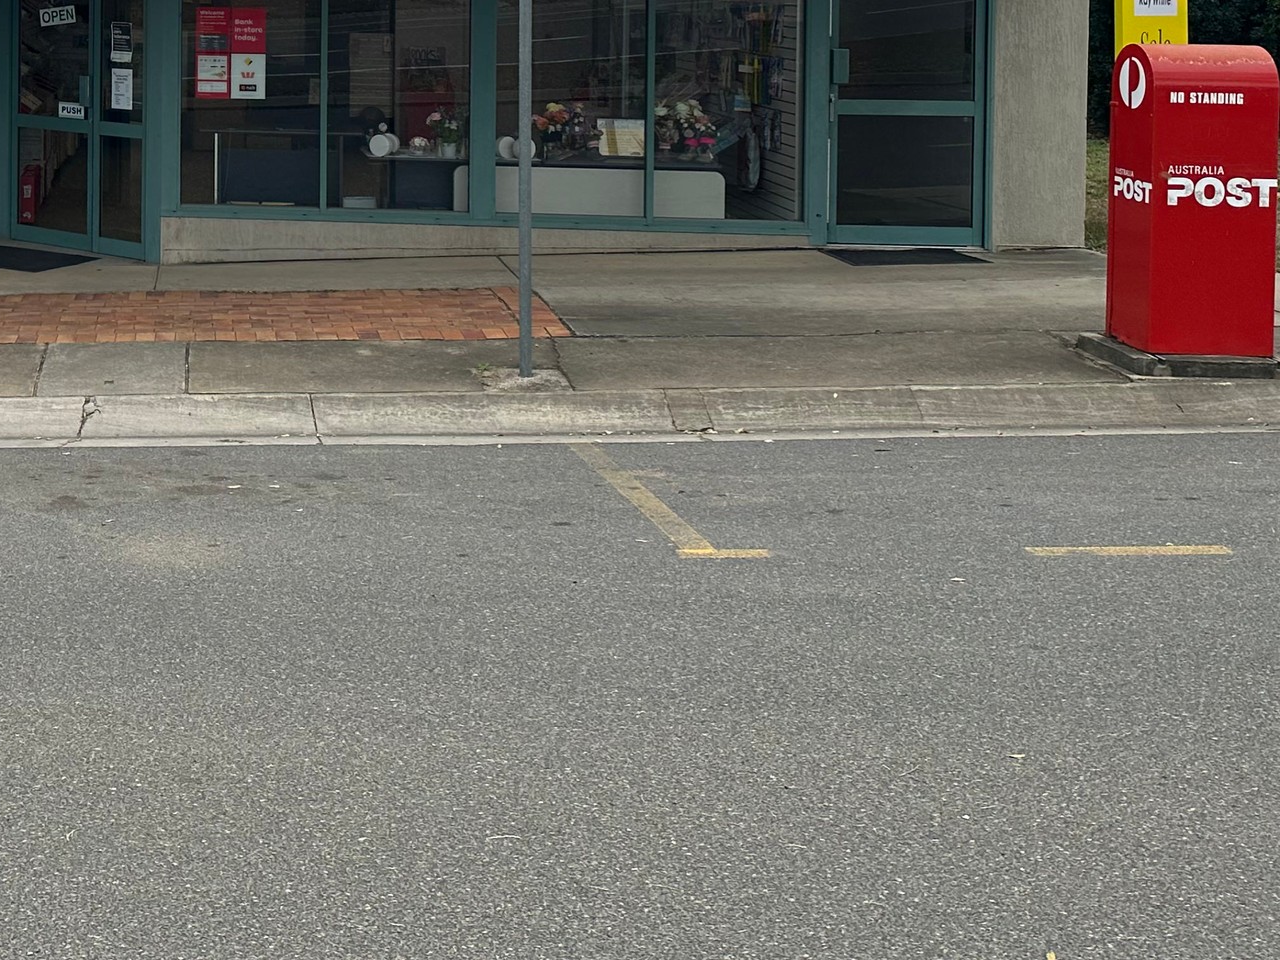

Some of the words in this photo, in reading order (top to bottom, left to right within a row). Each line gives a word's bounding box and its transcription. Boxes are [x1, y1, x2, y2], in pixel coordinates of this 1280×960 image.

[41, 7, 75, 24] OPEN
[1170, 91, 1185, 104] NO
[1189, 91, 1245, 105] STANDING
[61, 105, 82, 115] PUSH
[1167, 165, 1225, 176] AUSTRALIA
[1113, 175, 1153, 204] POST
[1167, 176, 1279, 208] POST
